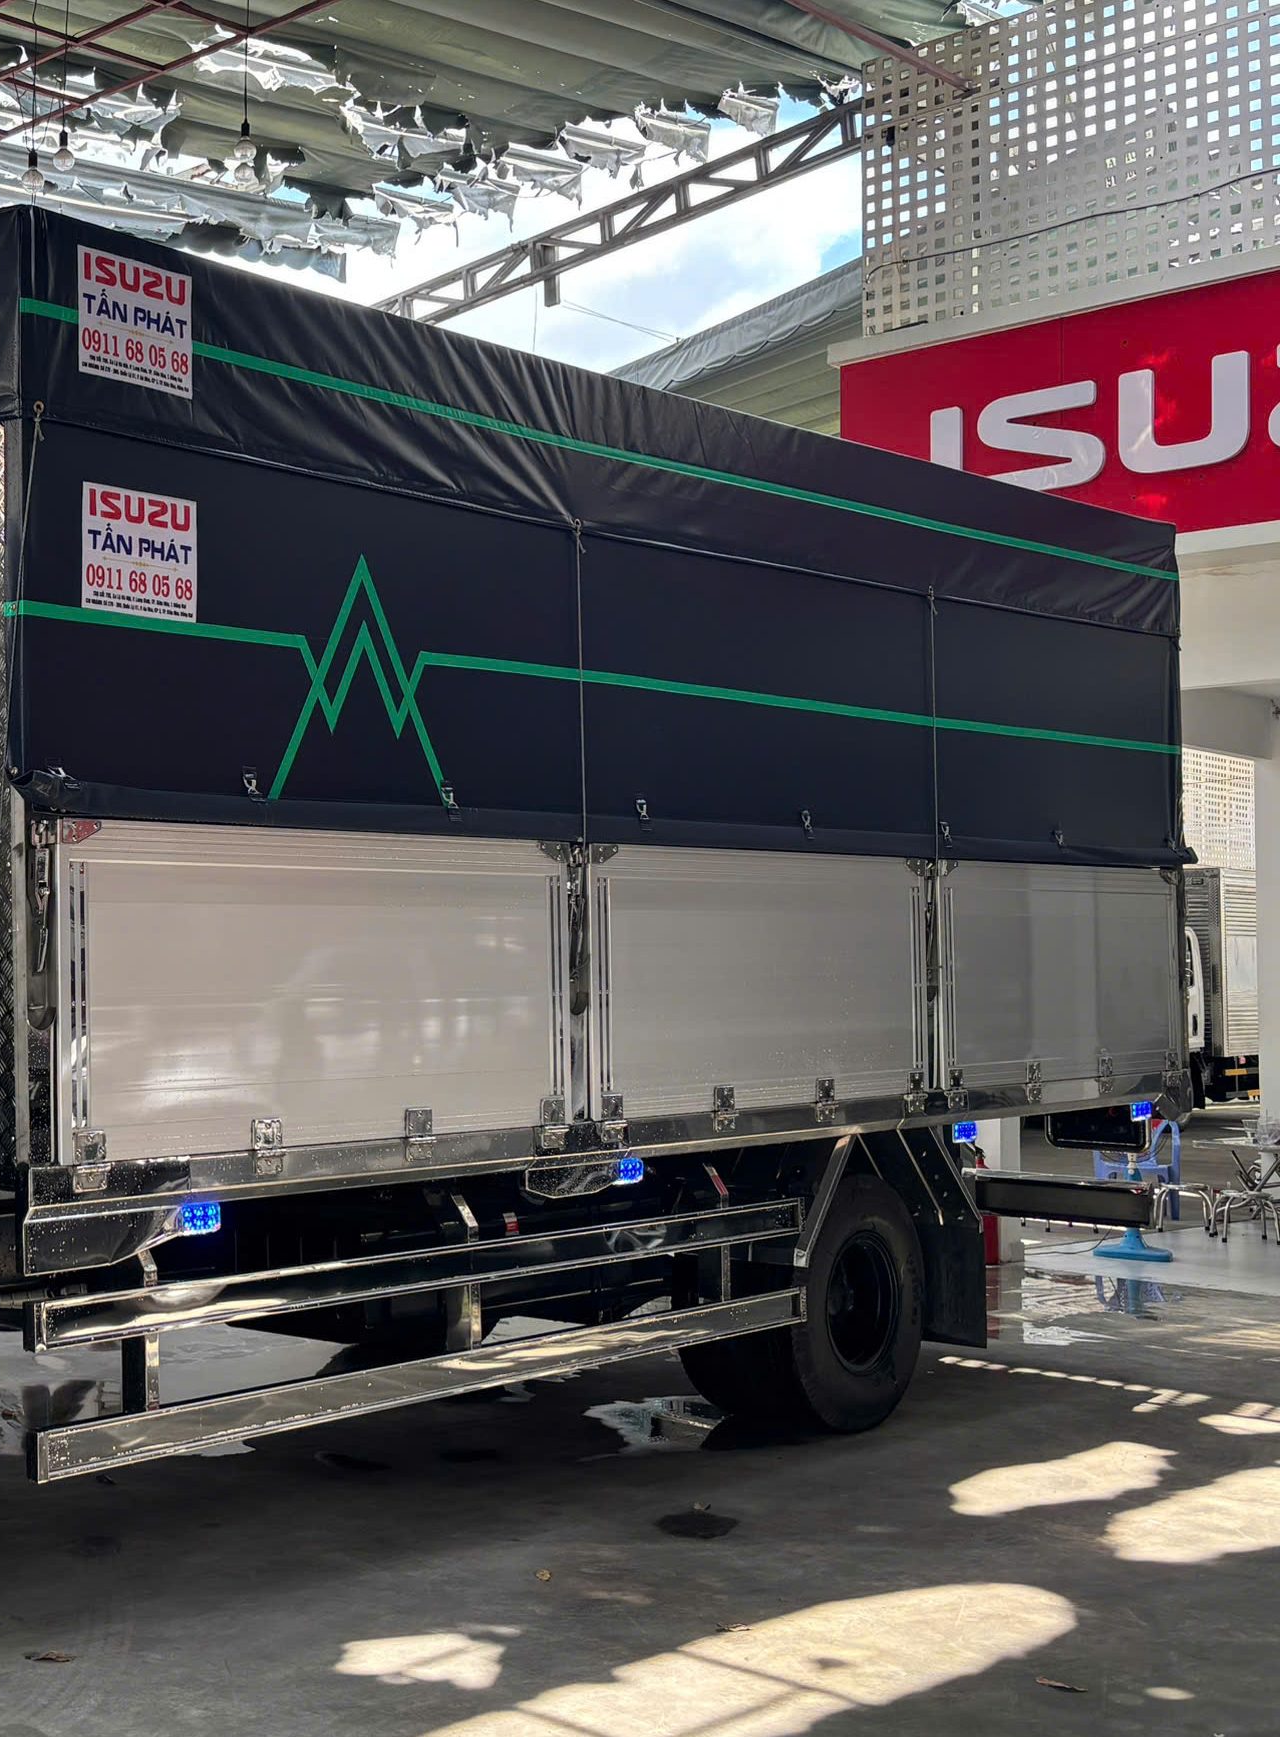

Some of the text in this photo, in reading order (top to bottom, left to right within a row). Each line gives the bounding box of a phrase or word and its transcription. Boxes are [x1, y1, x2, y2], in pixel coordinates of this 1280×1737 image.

[83, 252, 186, 306] ISUZU
[82, 288, 188, 339] TẤN PHÁT
[82, 327, 120, 357] 0911
[125, 338, 144, 363] 68
[148, 344, 167, 369] 05
[171, 351, 189, 375] 68
[930, 350, 1280, 492] ISU
[88, 488, 191, 532] ISUZU
[87, 522, 192, 565] TẤN PHÁT
[86, 563, 123, 590] 0911
[129, 570, 147, 594] 68
[152, 574, 170, 598] 05
[175, 577, 193, 601] 68
